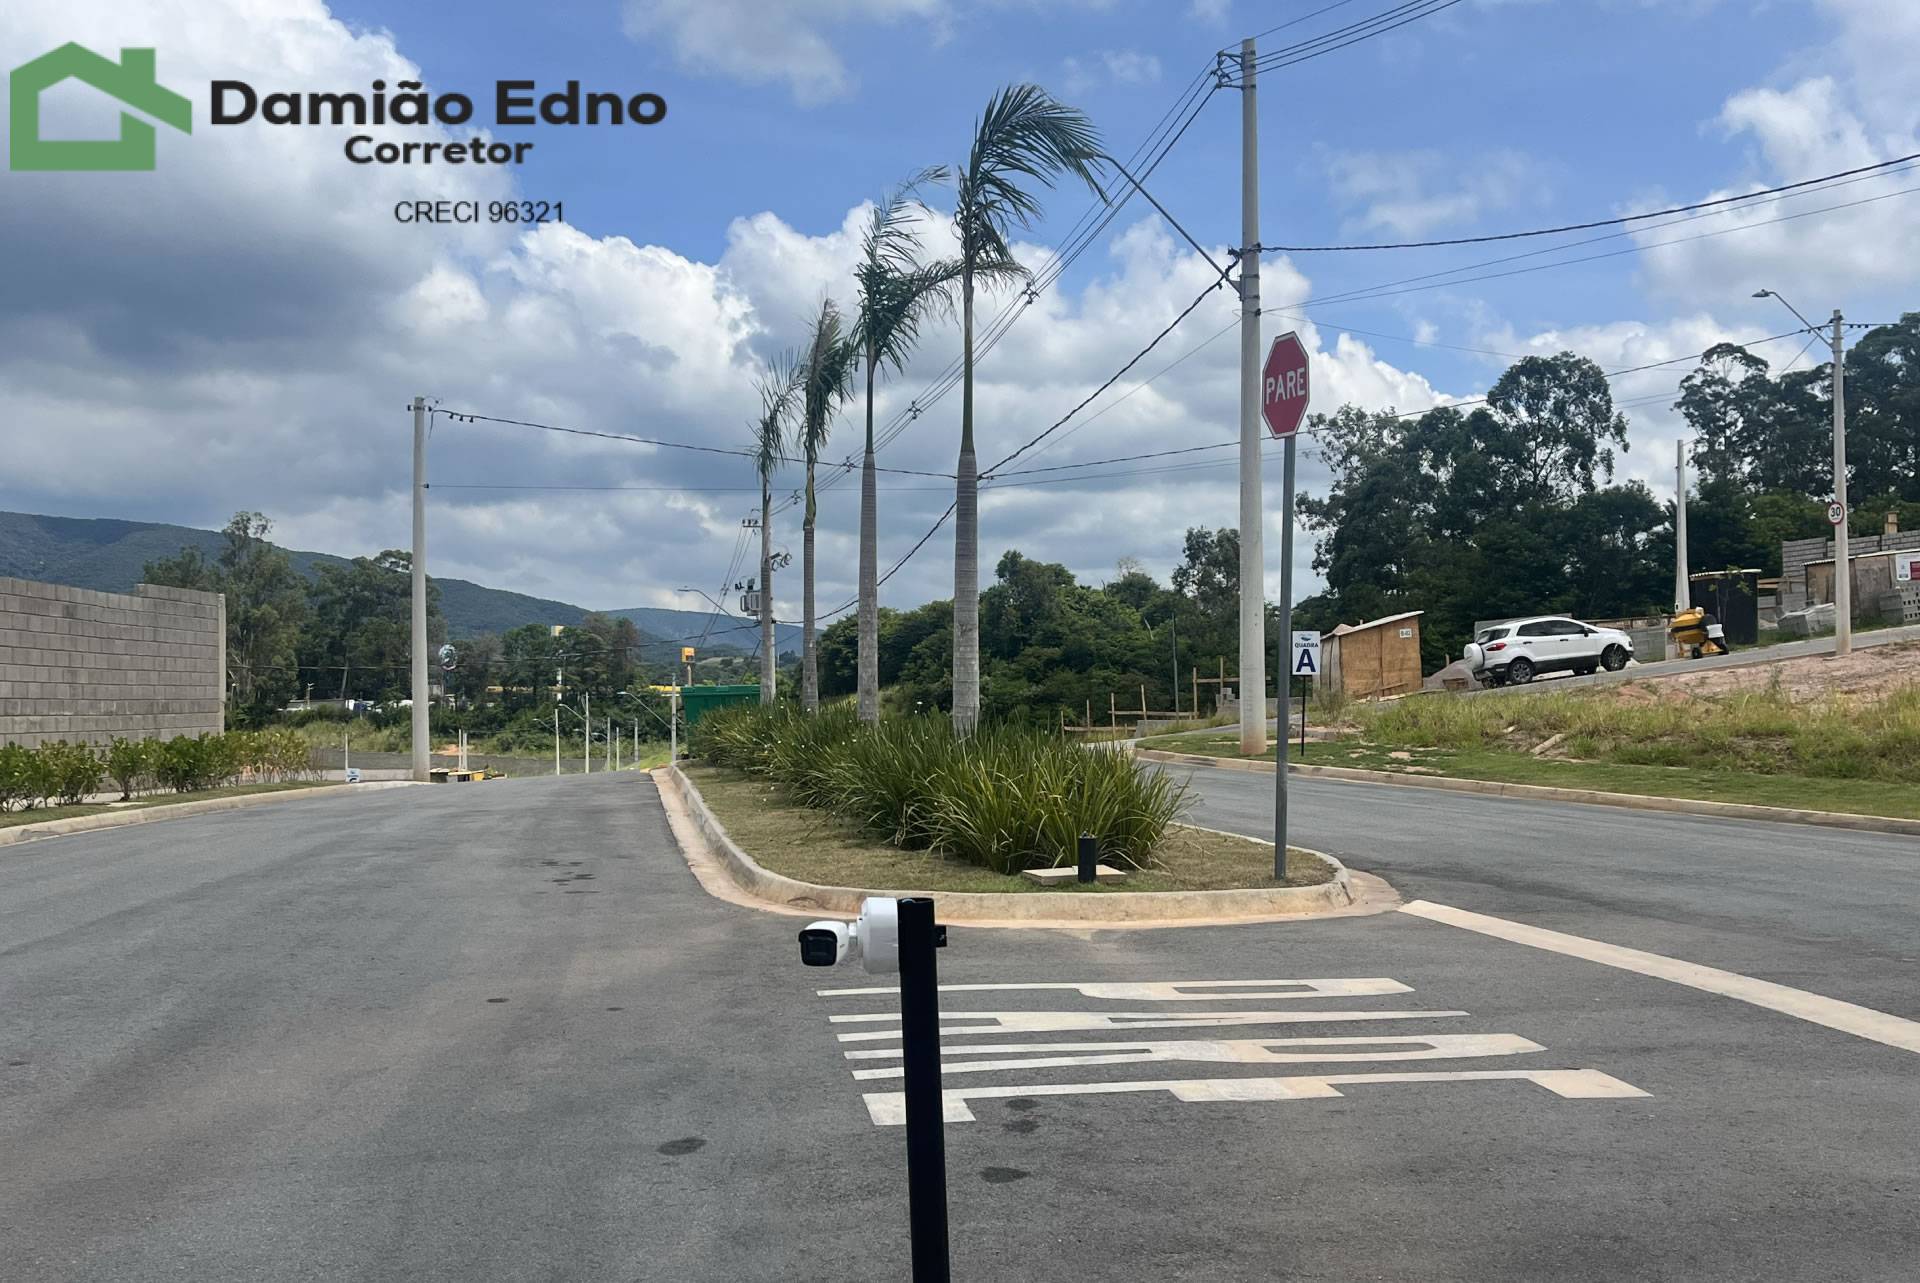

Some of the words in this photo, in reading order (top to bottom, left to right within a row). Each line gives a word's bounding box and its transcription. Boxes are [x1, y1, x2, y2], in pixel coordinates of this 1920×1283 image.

[1266, 367, 1305, 405] PARE
[1830, 506, 1841, 517] 30
[1296, 649, 1317, 673] A
